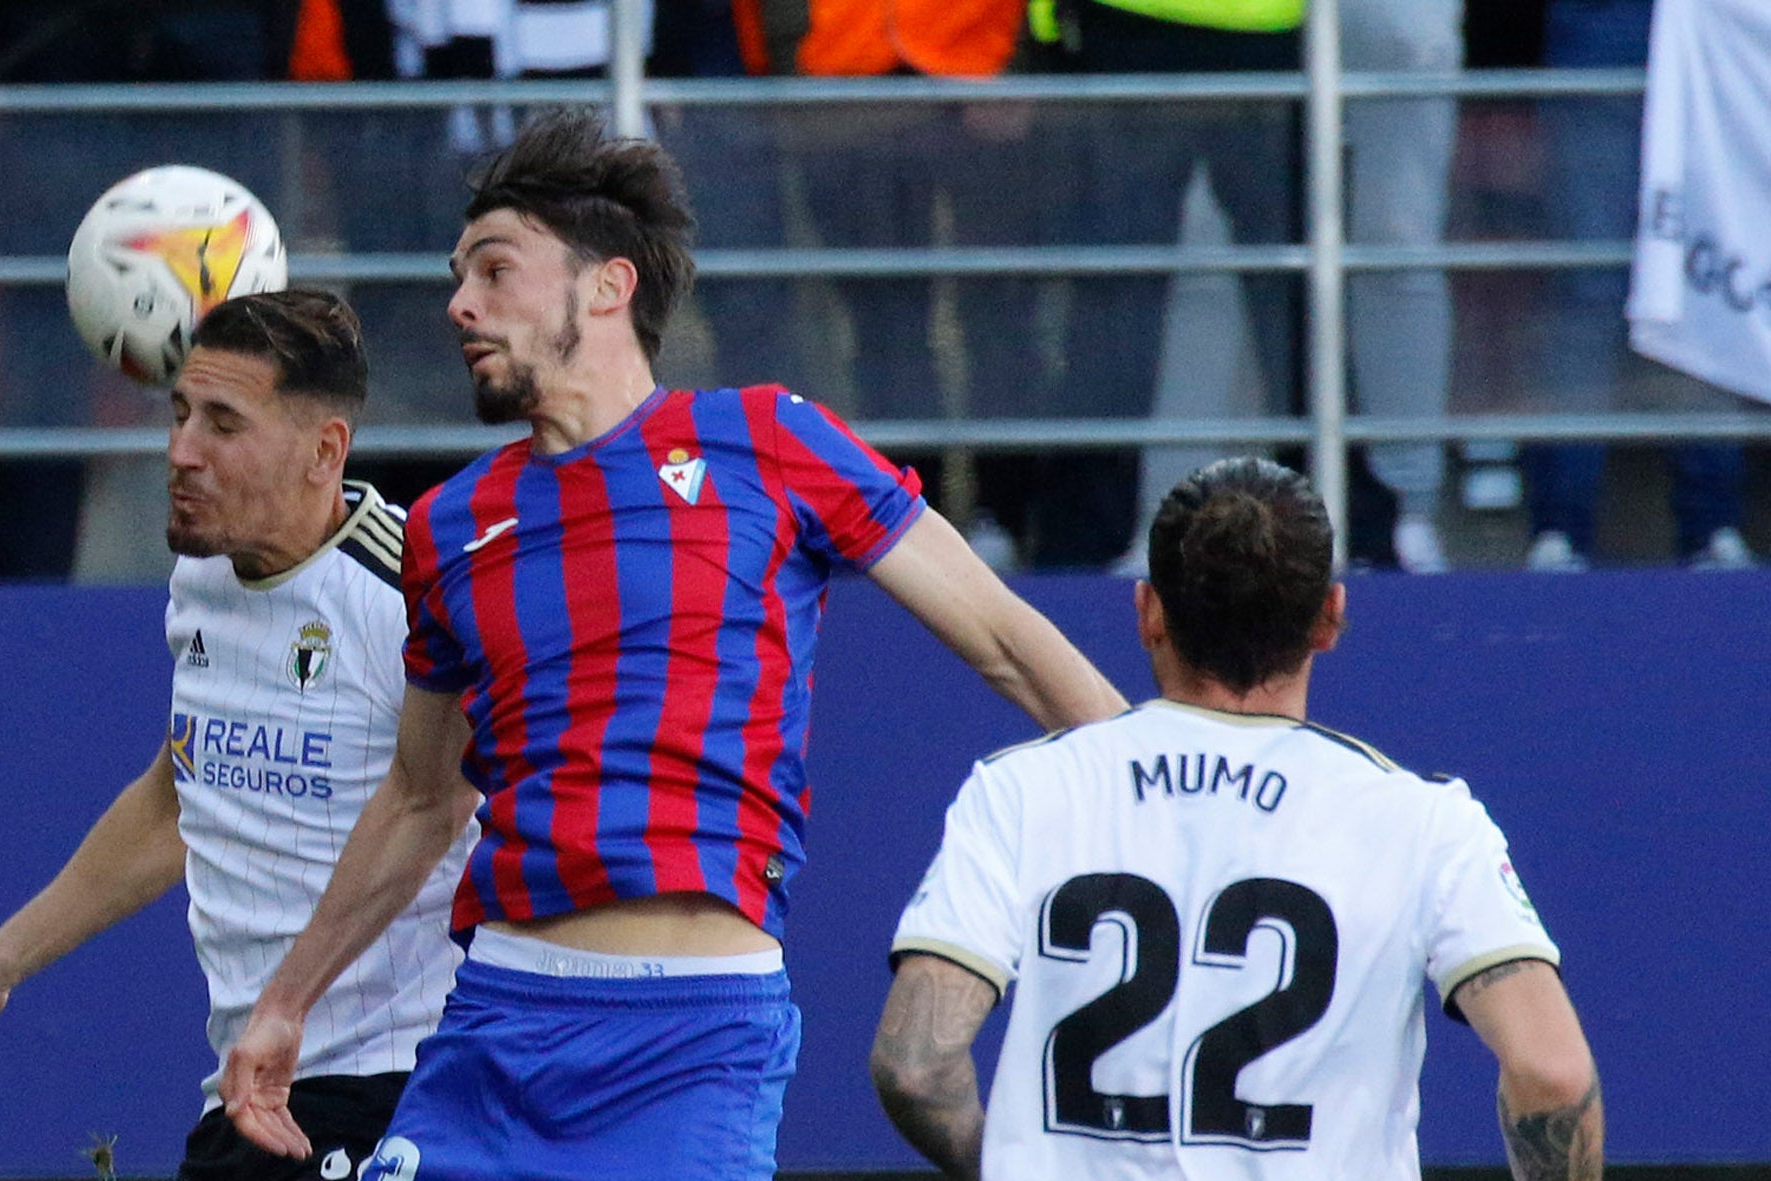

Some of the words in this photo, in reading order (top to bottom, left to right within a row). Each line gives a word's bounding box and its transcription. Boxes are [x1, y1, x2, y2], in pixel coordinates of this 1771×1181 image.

[204, 718, 332, 768] REALE
[203, 761, 333, 799] SEGUROS
[1129, 753, 1288, 813] MUMO
[1038, 873, 1339, 1152] 22
